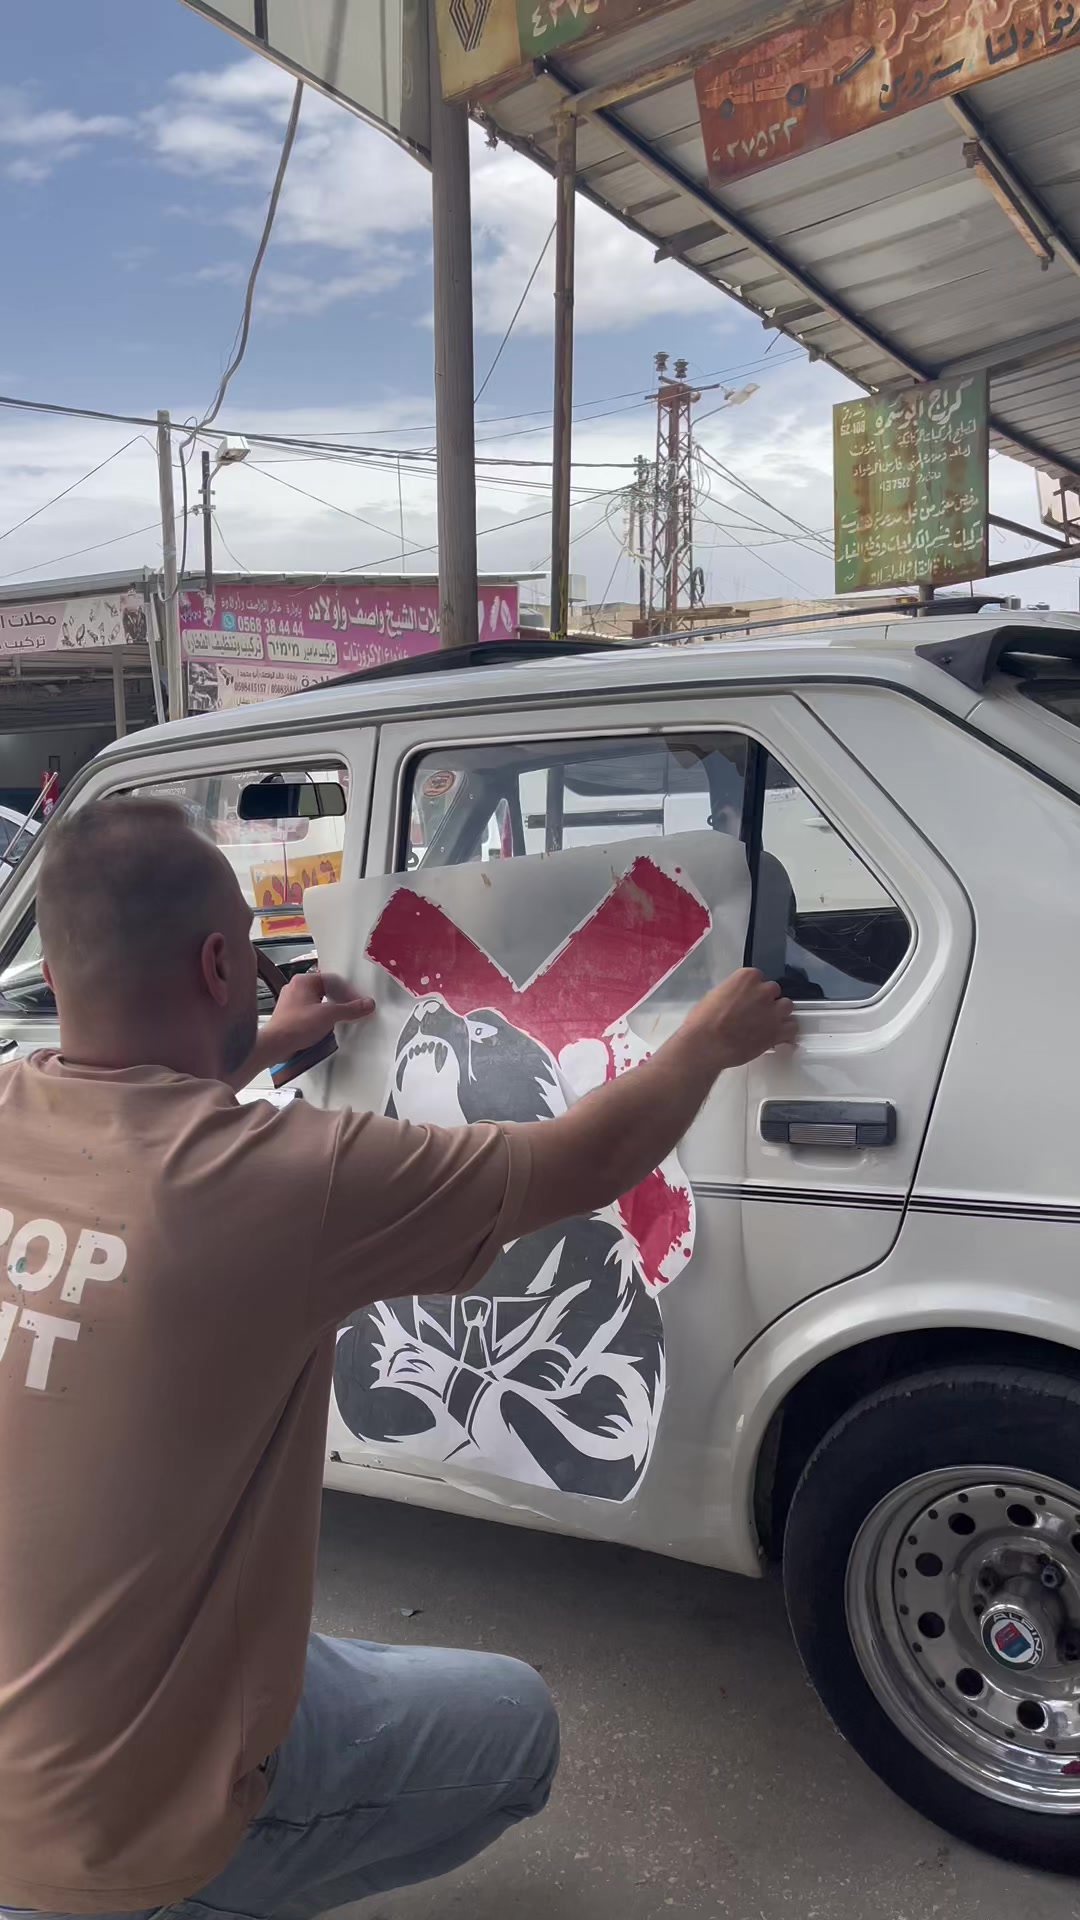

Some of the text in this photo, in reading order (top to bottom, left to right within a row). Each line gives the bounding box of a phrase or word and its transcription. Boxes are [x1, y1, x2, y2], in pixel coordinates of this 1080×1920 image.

[927, 377, 974, 424] كراج
[8, 612, 57, 629] محلات
[237, 615, 305, 637] 0568 38 44 44
[349, 597, 386, 634] واصف
[386, 601, 418, 637] الشيخ
[4, 635, 46, 649] تركيب
[992, 1612, 1043, 1665] ALPINA
